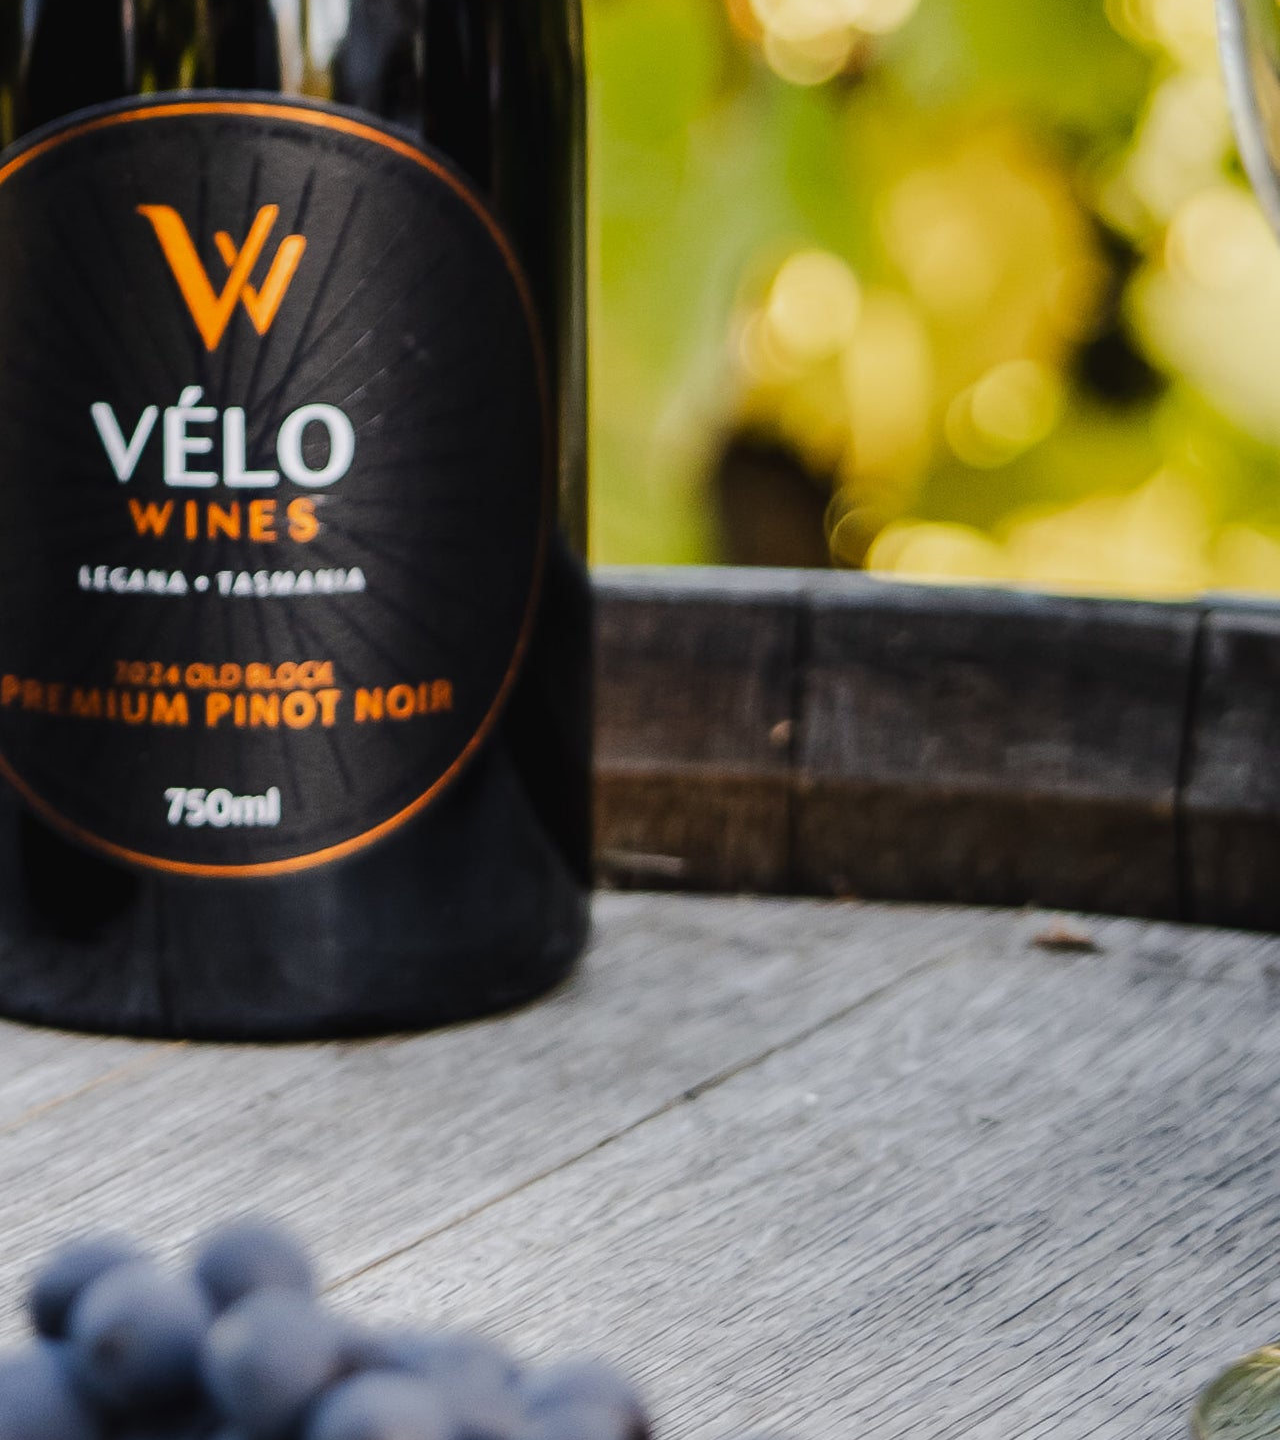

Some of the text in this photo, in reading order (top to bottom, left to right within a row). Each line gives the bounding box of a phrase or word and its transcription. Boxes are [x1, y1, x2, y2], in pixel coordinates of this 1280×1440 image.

[90, 385, 356, 488] VÉLO
[128, 496, 320, 543] WINES
[78, 565, 366, 598] LEGANA TASMANIA
[184, 662, 242, 689] OLD
[1, 674, 452, 730] PREMIUM PINOT NOIR
[164, 786, 281, 827] 750ml
